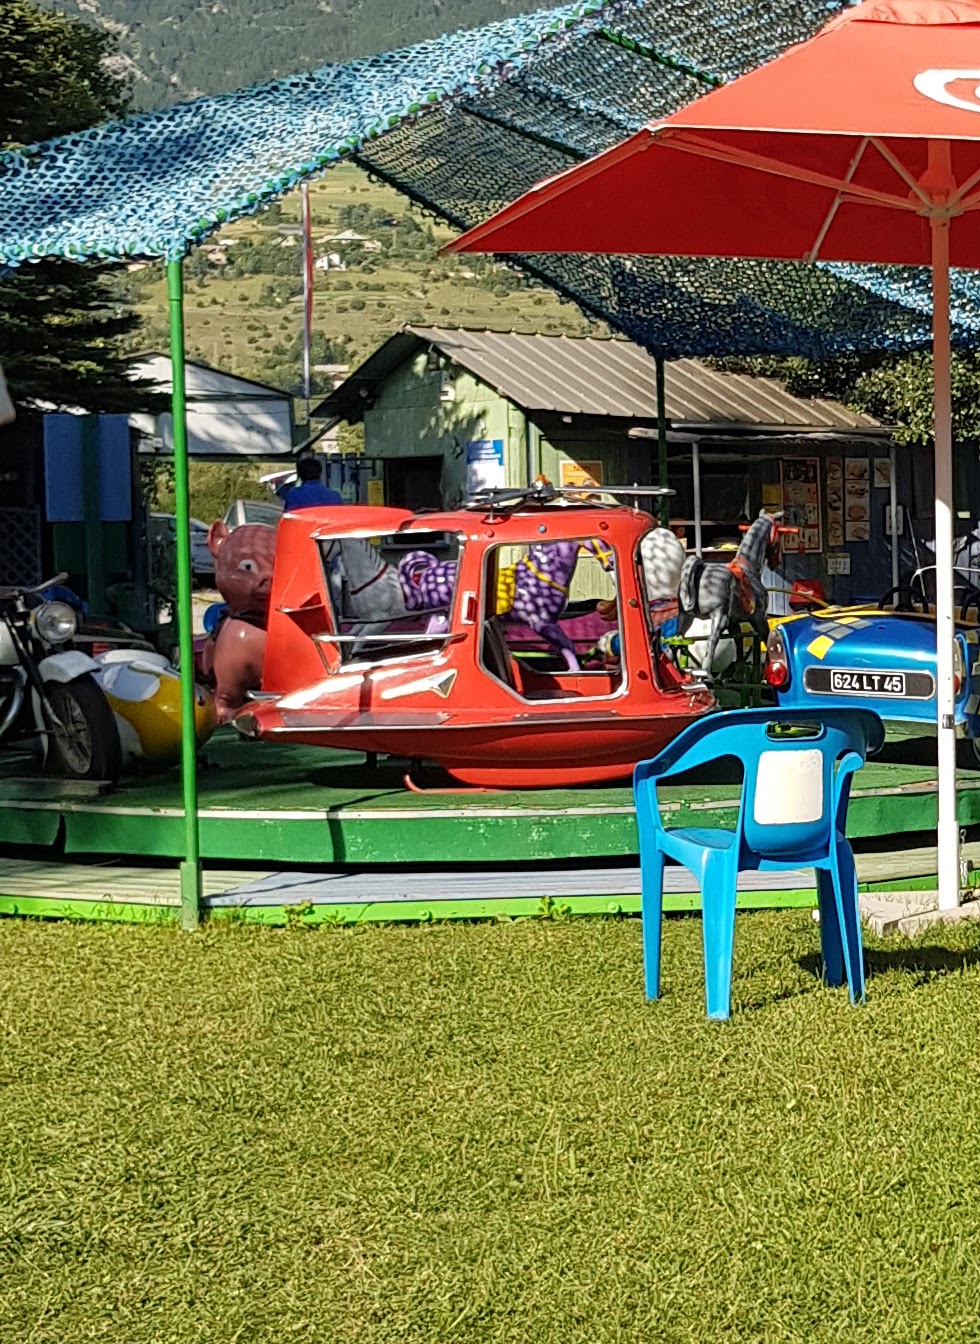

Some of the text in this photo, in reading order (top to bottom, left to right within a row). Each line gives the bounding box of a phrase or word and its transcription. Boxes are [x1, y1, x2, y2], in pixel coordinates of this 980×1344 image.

[834, 673, 902, 692] 624 LT 45
